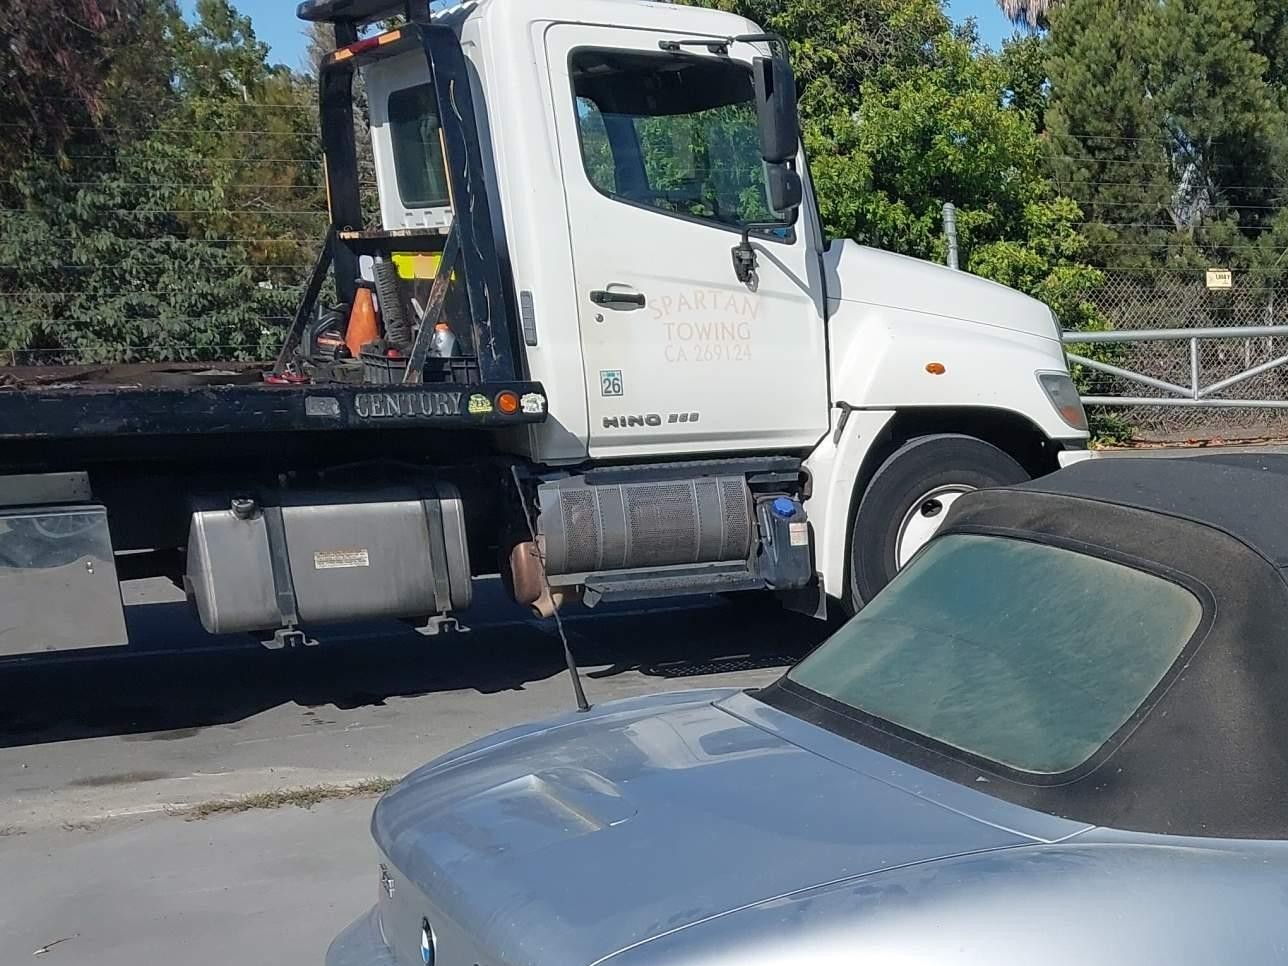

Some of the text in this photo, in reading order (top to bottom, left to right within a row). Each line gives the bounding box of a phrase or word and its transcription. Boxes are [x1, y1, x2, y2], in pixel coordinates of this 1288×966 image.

[648, 289, 760, 320] SPARTAN
[664, 321, 751, 341] TOWING
[664, 344, 752, 362] CA 269124
[603, 377, 621, 394] 26
[354, 392, 463, 418] CENTURY
[603, 413, 662, 428] HINO
